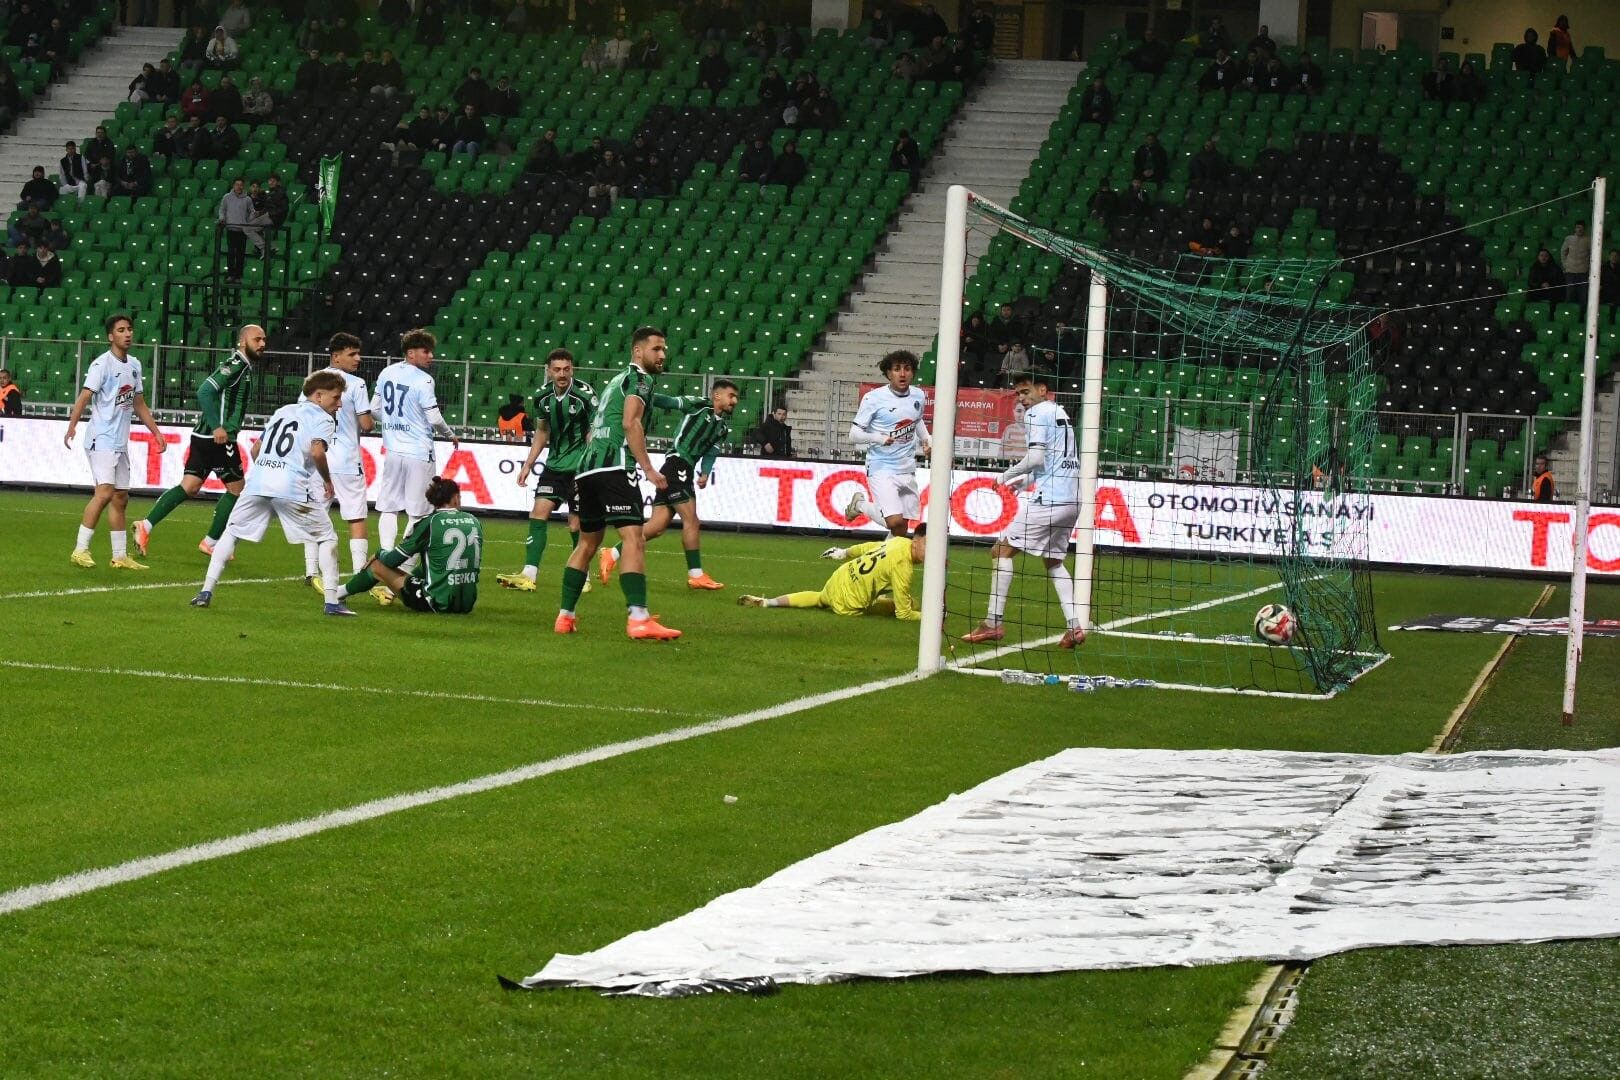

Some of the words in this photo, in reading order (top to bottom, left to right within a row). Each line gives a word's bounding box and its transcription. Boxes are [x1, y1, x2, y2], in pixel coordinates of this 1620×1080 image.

[383, 380, 410, 417] 97
[959, 400, 994, 410] AKARYA!
[264, 417, 299, 458] 16
[759, 467, 1142, 544] TOOA
[1147, 493, 1276, 515] OTOMOTİV
[442, 525, 480, 571] 21
[448, 571, 478, 586] SERKA
